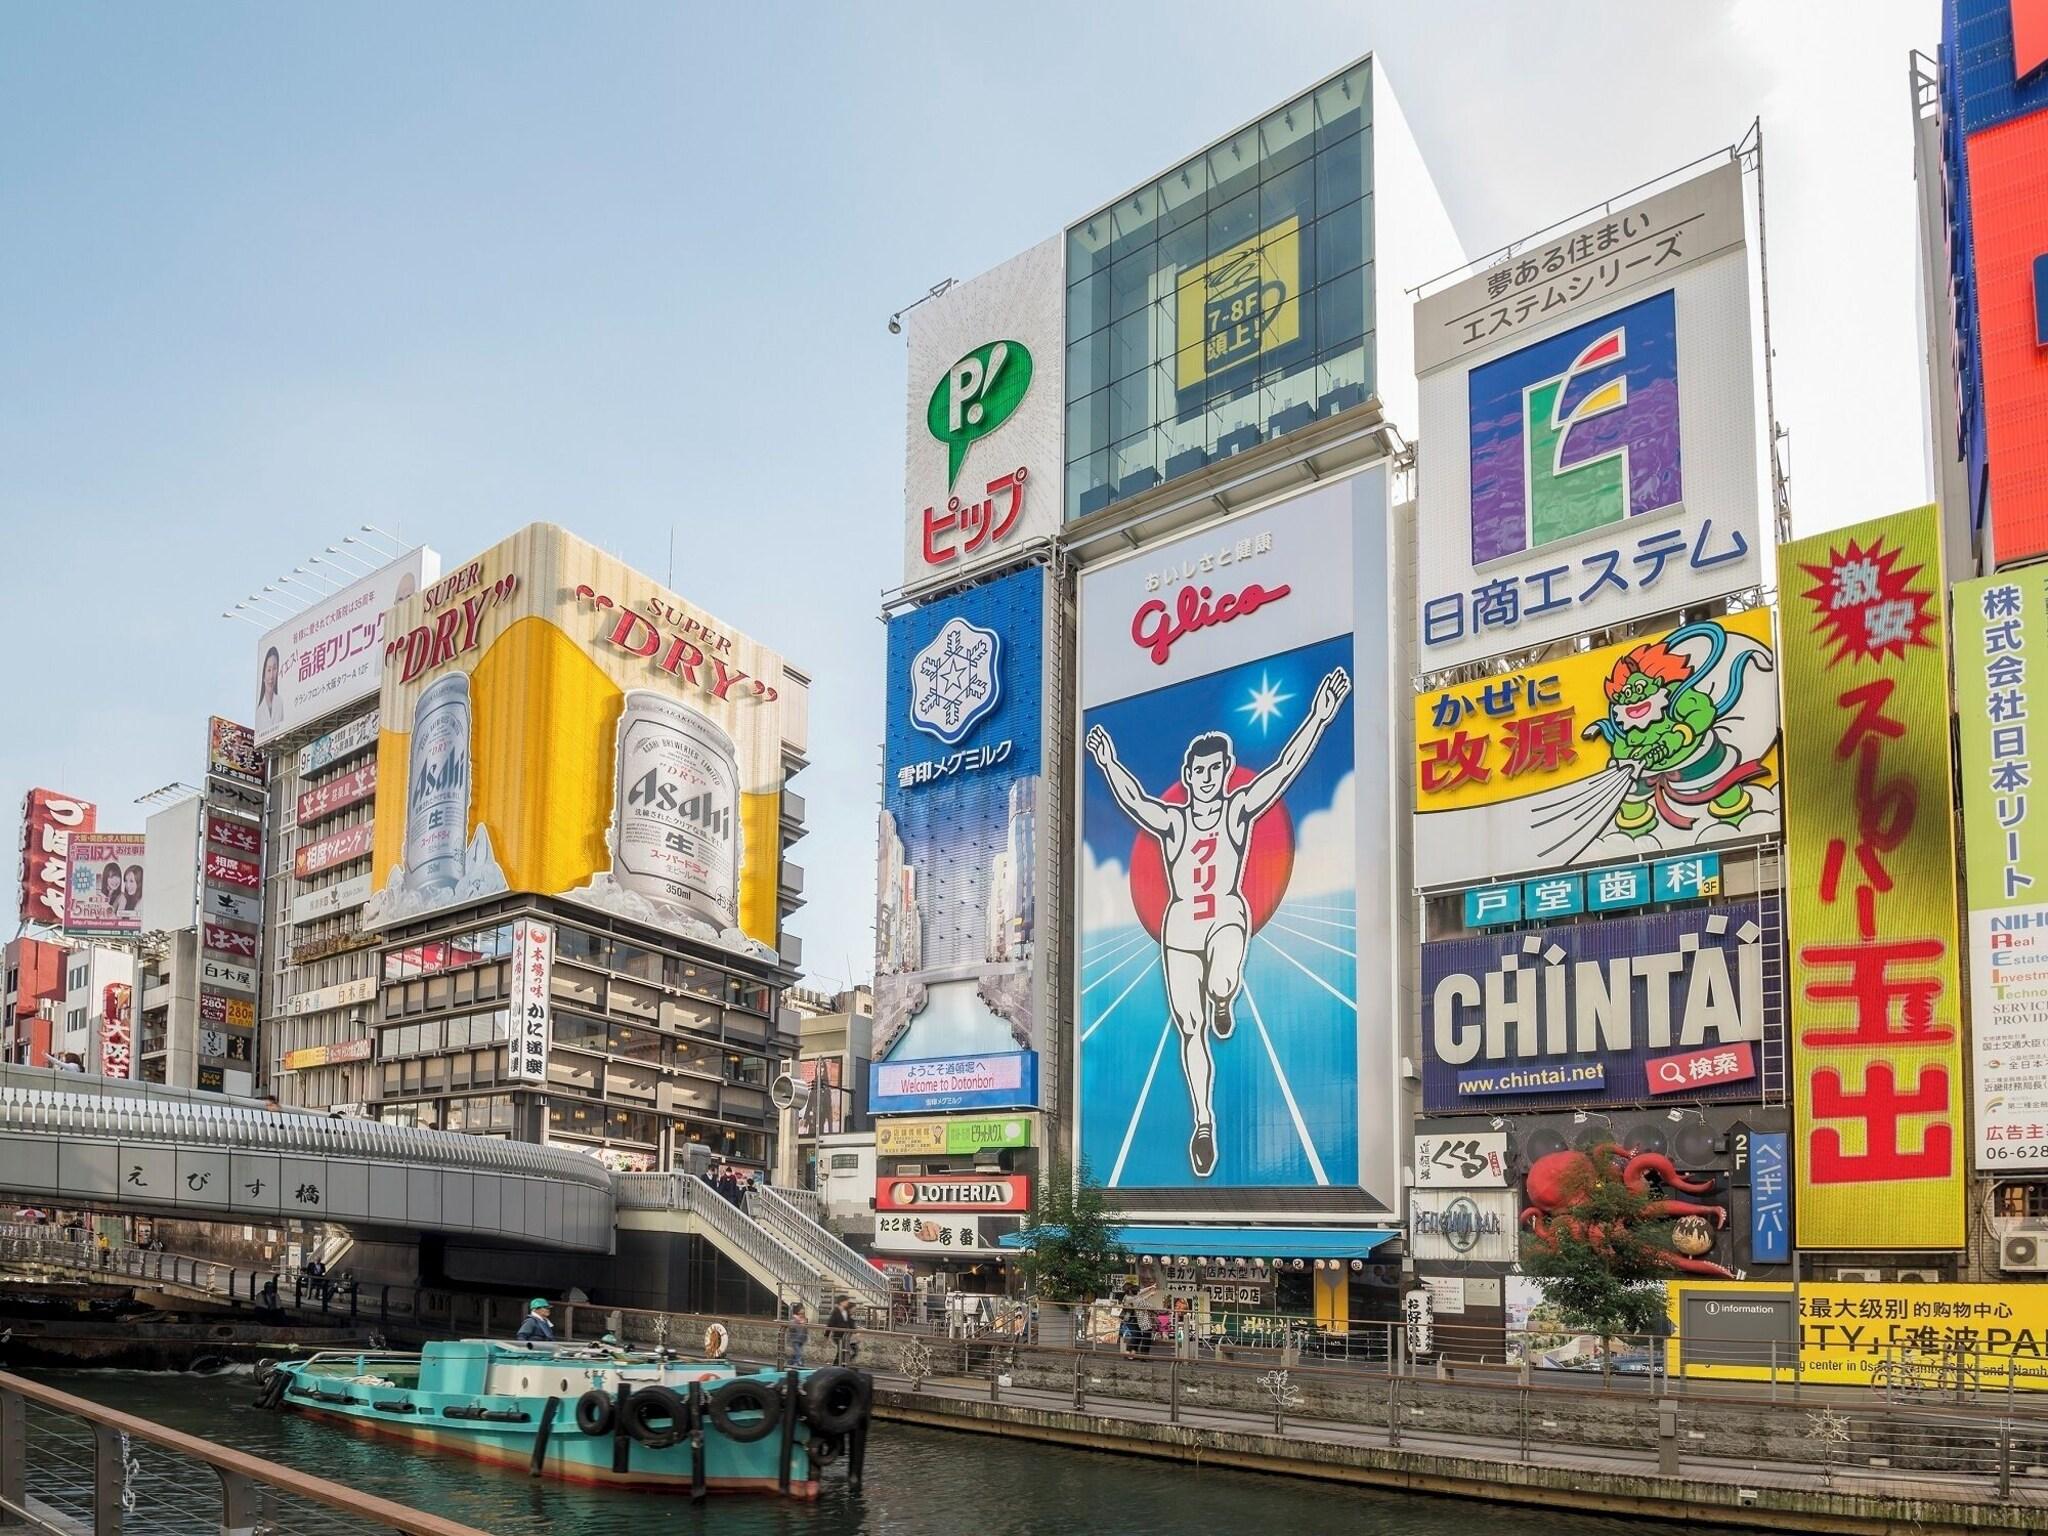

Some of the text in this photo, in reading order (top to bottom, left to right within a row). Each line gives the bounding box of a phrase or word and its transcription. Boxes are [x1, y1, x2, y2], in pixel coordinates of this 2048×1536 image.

[1487, 212, 1650, 300] 夢ある住まい
[1462, 231, 1683, 345] エステムシリーズ
[922, 465, 1029, 565] ピップ
[1145, 531, 1273, 592] おいしさと健康
[423, 562, 479, 614] SUPER
[1424, 518, 1748, 647] 日商エステム
[1832, 558, 1914, 648] 激安
[646, 596, 733, 656] SUPER
[1132, 584, 1292, 665] Glico
[1431, 674, 1562, 727] かぜに
[1418, 705, 1579, 793] 改源
[1983, 585, 2033, 897] 株式会社日本リート
[300, 751, 311, 771] 9F
[898, 739, 1013, 789] 雪印メグミルク
[412, 746, 466, 810] Asahi
[628, 767, 729, 841] Asahi
[428, 808, 444, 831] 生
[75, 845, 118, 862] 高収入
[665, 831, 695, 858] 生
[206, 863, 258, 887] ダイニング
[215, 855, 239, 871] 相席
[650, 848, 709, 878] スーパードライ
[1190, 831, 1219, 921] グリコ
[666, 883, 691, 901] 350ml
[1475, 858, 1717, 920] 戸堂歯科 3F
[1990, 911, 2048, 932] NIH
[1991, 933, 2035, 949] Real
[204, 962, 251, 985] 白木屋
[338, 985, 368, 1005] 白木屋
[525, 947, 546, 1075] 本場の味 かに道楽
[906, 1060, 987, 1078] ようこそ道頓堀へ
[1688, 1052, 1739, 1081] 検索
[900, 1078, 938, 1093] Welcome
[939, 1077, 949, 1091] to
[1986, 1123, 2048, 1141] 広告主
[1431, 1140, 1489, 1179] くくる
[1735, 1134, 1748, 1170] 2F
[1986, 1145, 2048, 1160] 06-628
[127, 1165, 321, 1205] えびす橋
[918, 1184, 1000, 1202] LOTTERIA
[1756, 1143, 1783, 1250] ペンギンバー
[879, 1217, 923, 1233] たこ焼き
[938, 1227, 975, 1246] 壱番
[1167, 1265, 1196, 1280] 串カツ
[1721, 1304, 1774, 1314] information
[1913, 1301, 2014, 1319] 的购物中心
[1809, 1360, 1843, 1372] center
[1846, 1361, 1857, 1371] in
